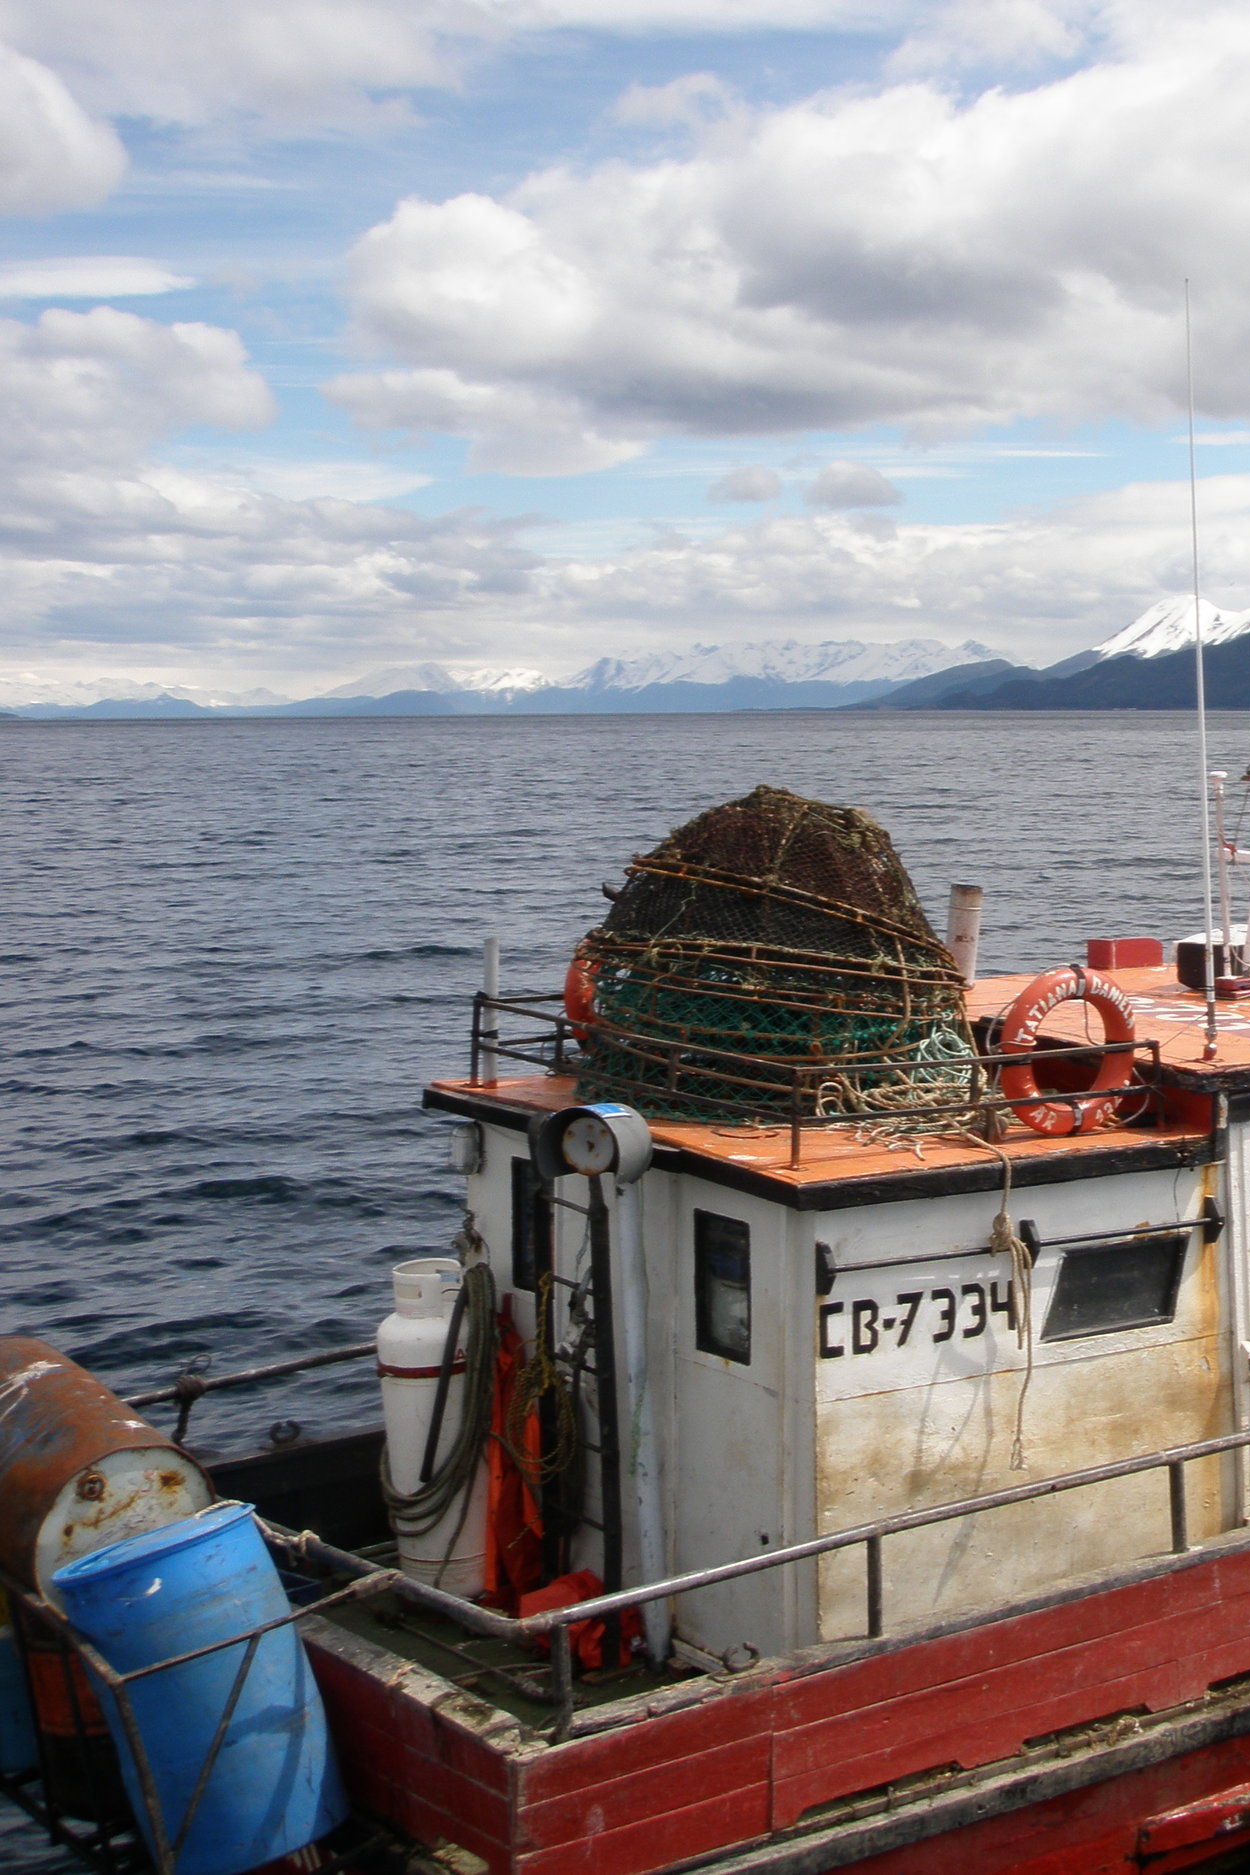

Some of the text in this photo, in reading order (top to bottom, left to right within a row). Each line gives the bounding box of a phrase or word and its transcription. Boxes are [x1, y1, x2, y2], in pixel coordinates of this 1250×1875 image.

[1015, 975, 1137, 1042] TATIANA DANIELA
[818, 1279, 1017, 1360] CB-7334
